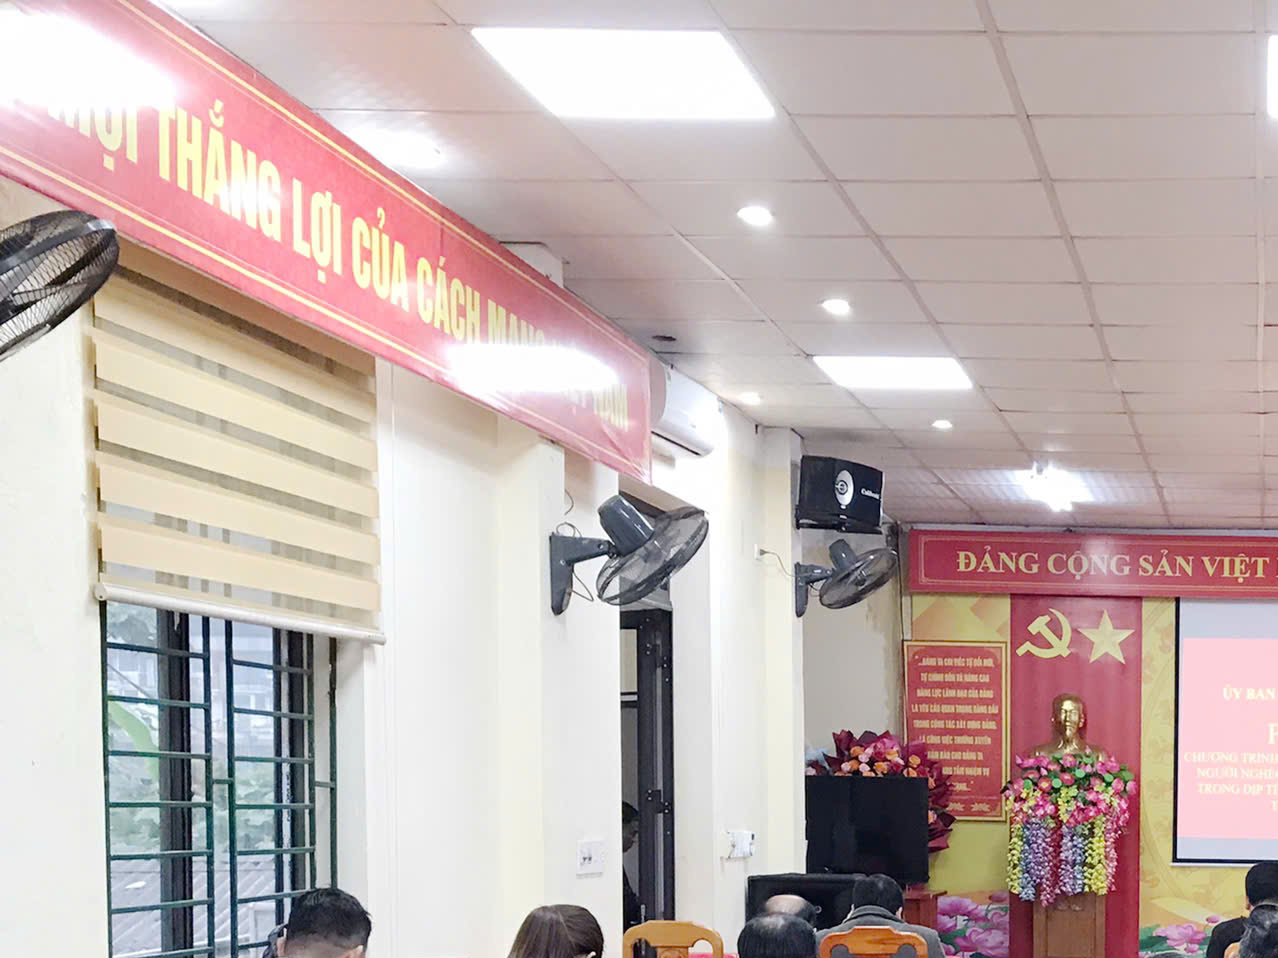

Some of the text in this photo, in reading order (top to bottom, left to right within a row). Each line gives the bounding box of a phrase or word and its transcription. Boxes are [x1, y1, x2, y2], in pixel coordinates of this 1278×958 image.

[293, 178, 342, 283] LỢI
[352, 207, 409, 313] CỦA
[416, 256, 480, 346] CÁCH
[957, 546, 1039, 574] ĐẢNG
[1047, 551, 1130, 580] CỘNG
[1138, 549, 1194, 577] SẢN
[1201, 553, 1269, 583] VIỆT
[1246, 687, 1276, 700] BAN
